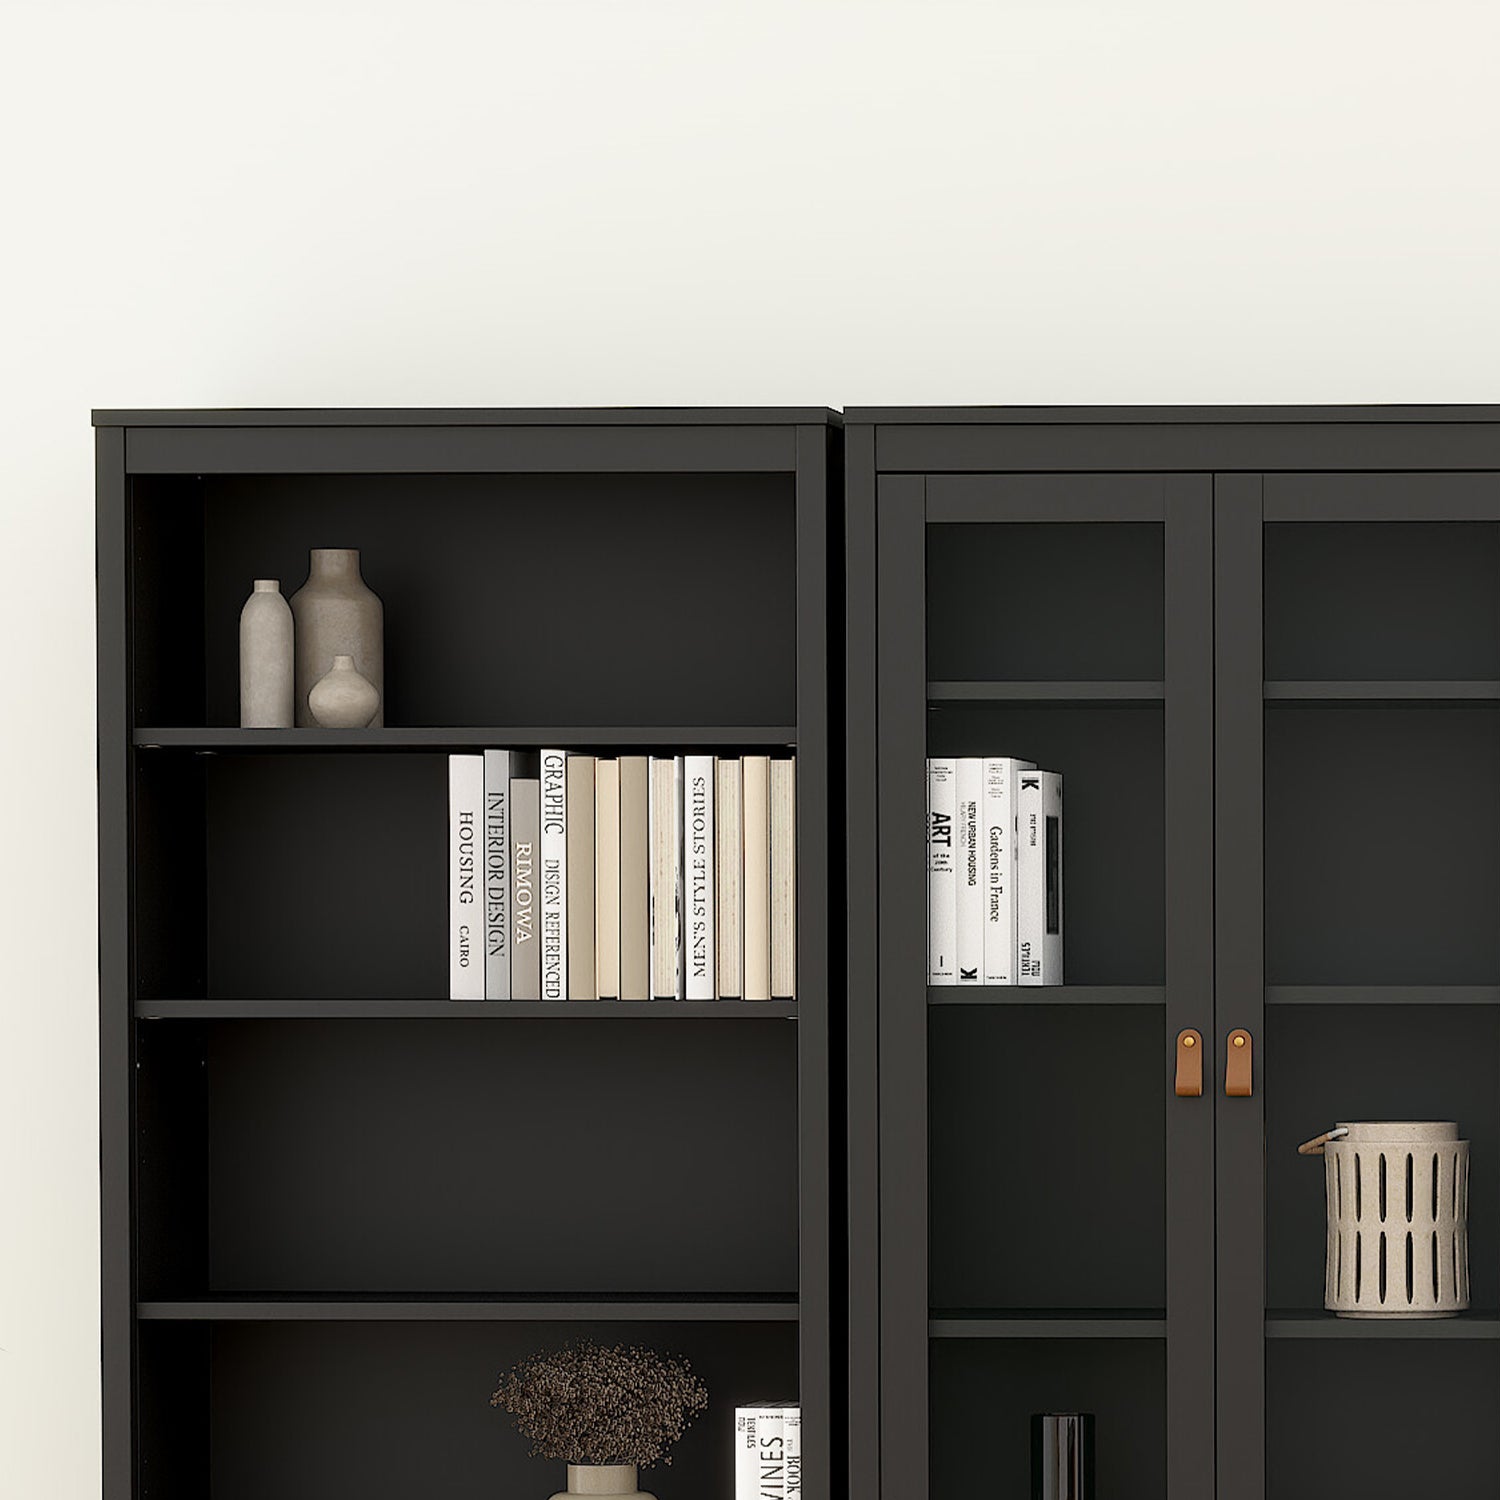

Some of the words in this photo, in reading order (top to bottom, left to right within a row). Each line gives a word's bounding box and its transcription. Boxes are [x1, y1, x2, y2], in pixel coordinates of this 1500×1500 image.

[544, 755, 564, 835] GRAPHIC
[1021, 779, 1040, 790] K
[692, 776, 706, 855] STORIES
[931, 811, 952, 847] ART
[967, 801, 977, 820] NEW
[459, 811, 474, 905] HOUSING
[487, 792, 505, 882] INTERIOR
[967, 821, 977, 849] URBAN
[989, 825, 1003, 871] Gardens
[693, 859, 706, 917] STYLE
[967, 849, 977, 887] HOUSING
[990, 872, 1003, 884] in
[515, 841, 533, 945] RIMOWA
[989, 886, 1003, 922] France
[487, 887, 506, 957] DESIGN
[459, 925, 470, 968] CAIRO
[544, 911, 561, 999] REFERENCED
[693, 921, 706, 977] MEN'S
[786, 1455, 800, 1494] BOOK
